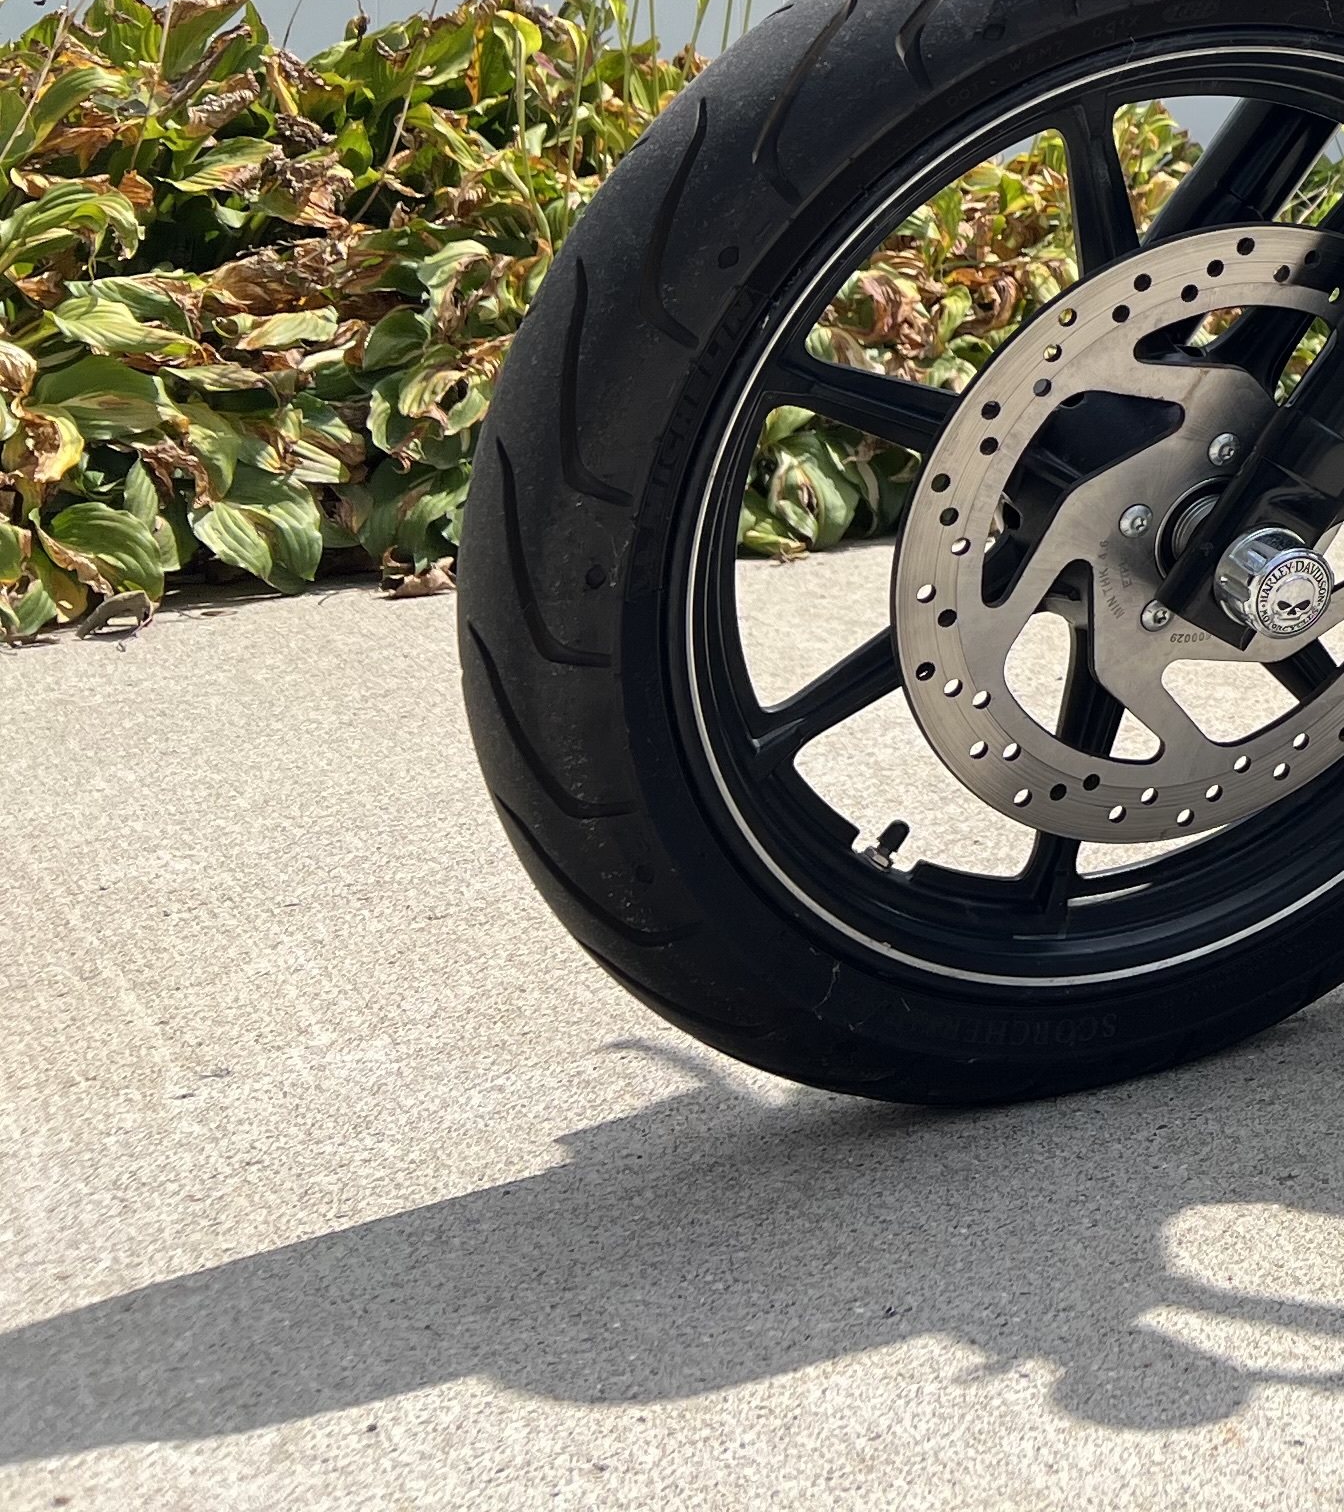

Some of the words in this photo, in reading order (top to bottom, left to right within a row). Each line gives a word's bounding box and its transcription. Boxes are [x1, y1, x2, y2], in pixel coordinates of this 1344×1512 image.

[1097, 568, 1113, 593] THK
[1260, 560, 1328, 604] HARLEY-DAVIDSON
[1107, 597, 1126, 619] MIN
